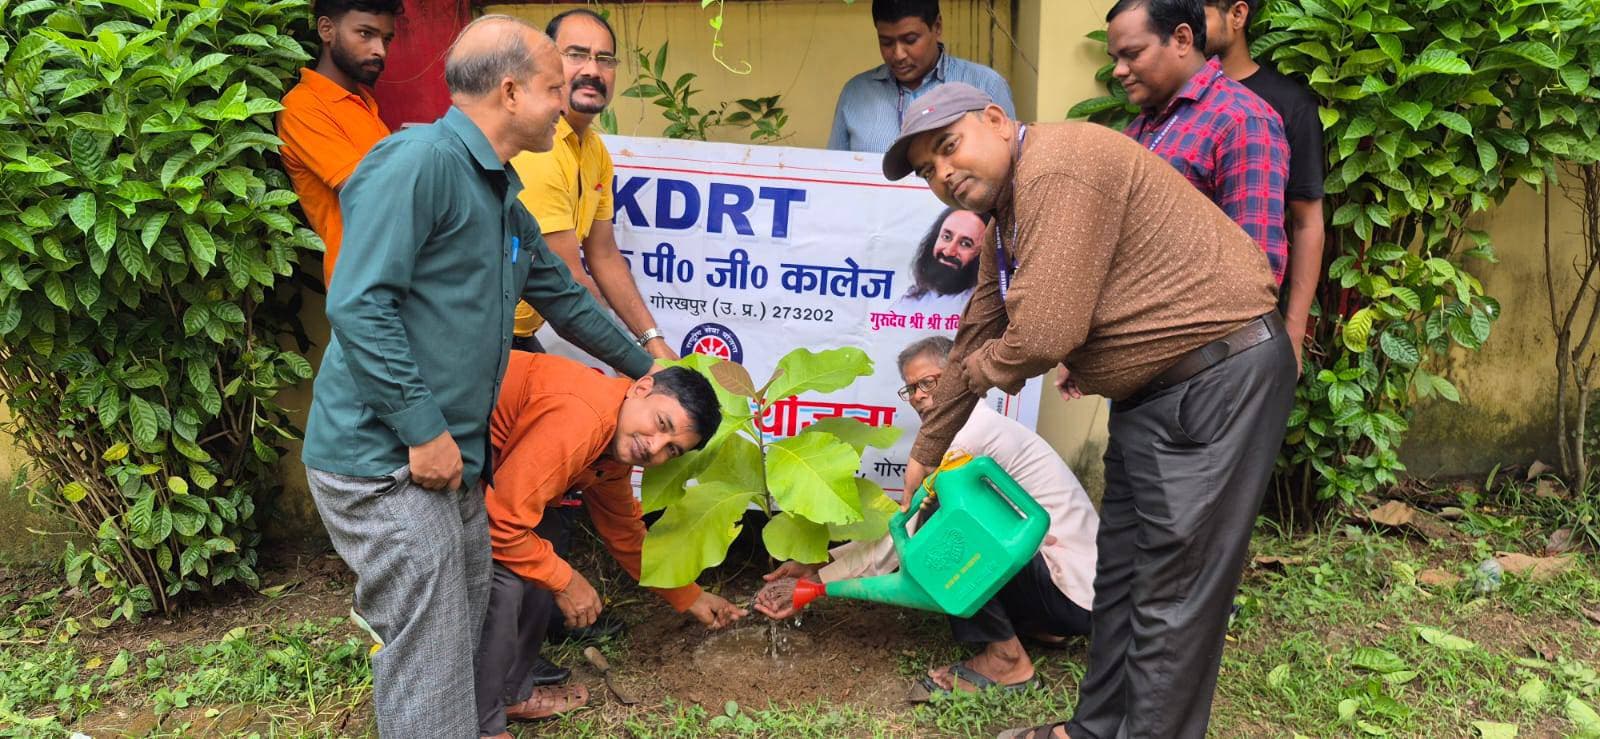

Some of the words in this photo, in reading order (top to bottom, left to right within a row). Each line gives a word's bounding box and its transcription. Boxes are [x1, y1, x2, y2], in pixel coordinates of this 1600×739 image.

[780, 257, 895, 300] कालेज
[649, 292, 708, 316] गोरखपुर
[772, 305, 834, 322] 273202
[909, 312, 925, 329] श्री
[927, 313, 943, 330] श्री
